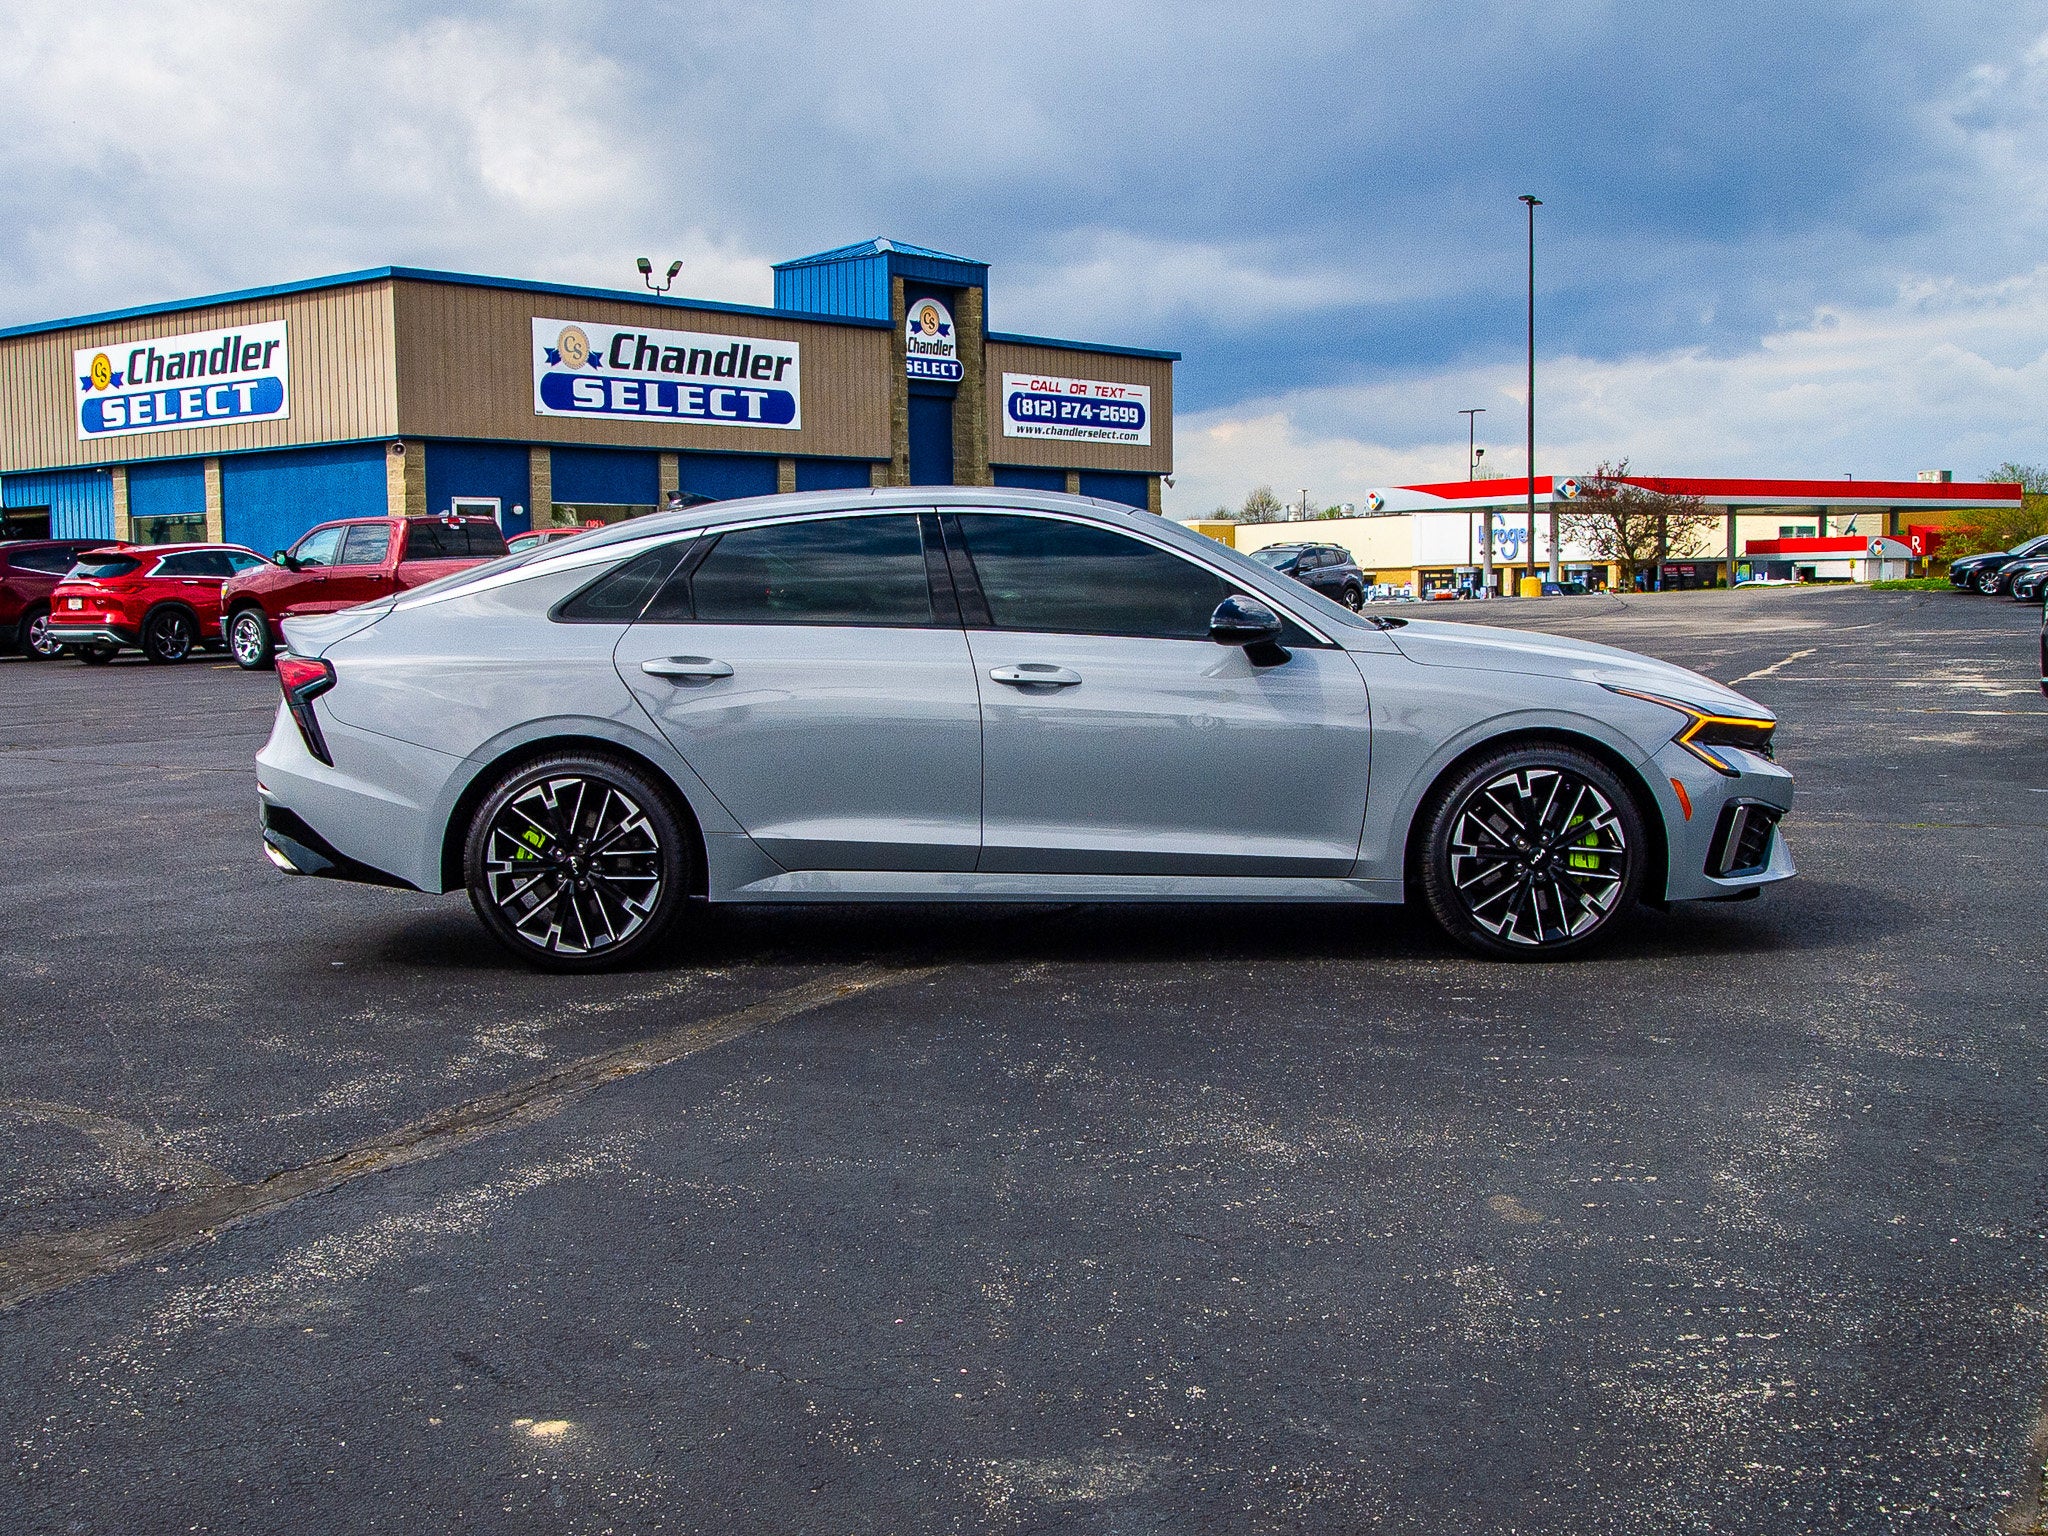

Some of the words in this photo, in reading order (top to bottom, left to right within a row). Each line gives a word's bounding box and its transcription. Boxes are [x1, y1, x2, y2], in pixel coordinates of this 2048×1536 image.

[127, 335, 281, 385] Chandler
[608, 332, 793, 382] Chandler
[908, 337, 954, 356] Chandler
[906, 360, 958, 377] SELECT
[101, 381, 259, 428] SELECT
[572, 378, 769, 419] SELECT
[1030, 380, 1062, 393] CALL
[1069, 383, 1088, 395] OR
[1094, 386, 1126, 398] TEXT
[1016, 397, 1057, 419] (812)
[1061, 401, 1139, 424] 274-2699
[1016, 425, 1139, 441] www.chandlerselect.com
[1478, 513, 1536, 560] Kroge
